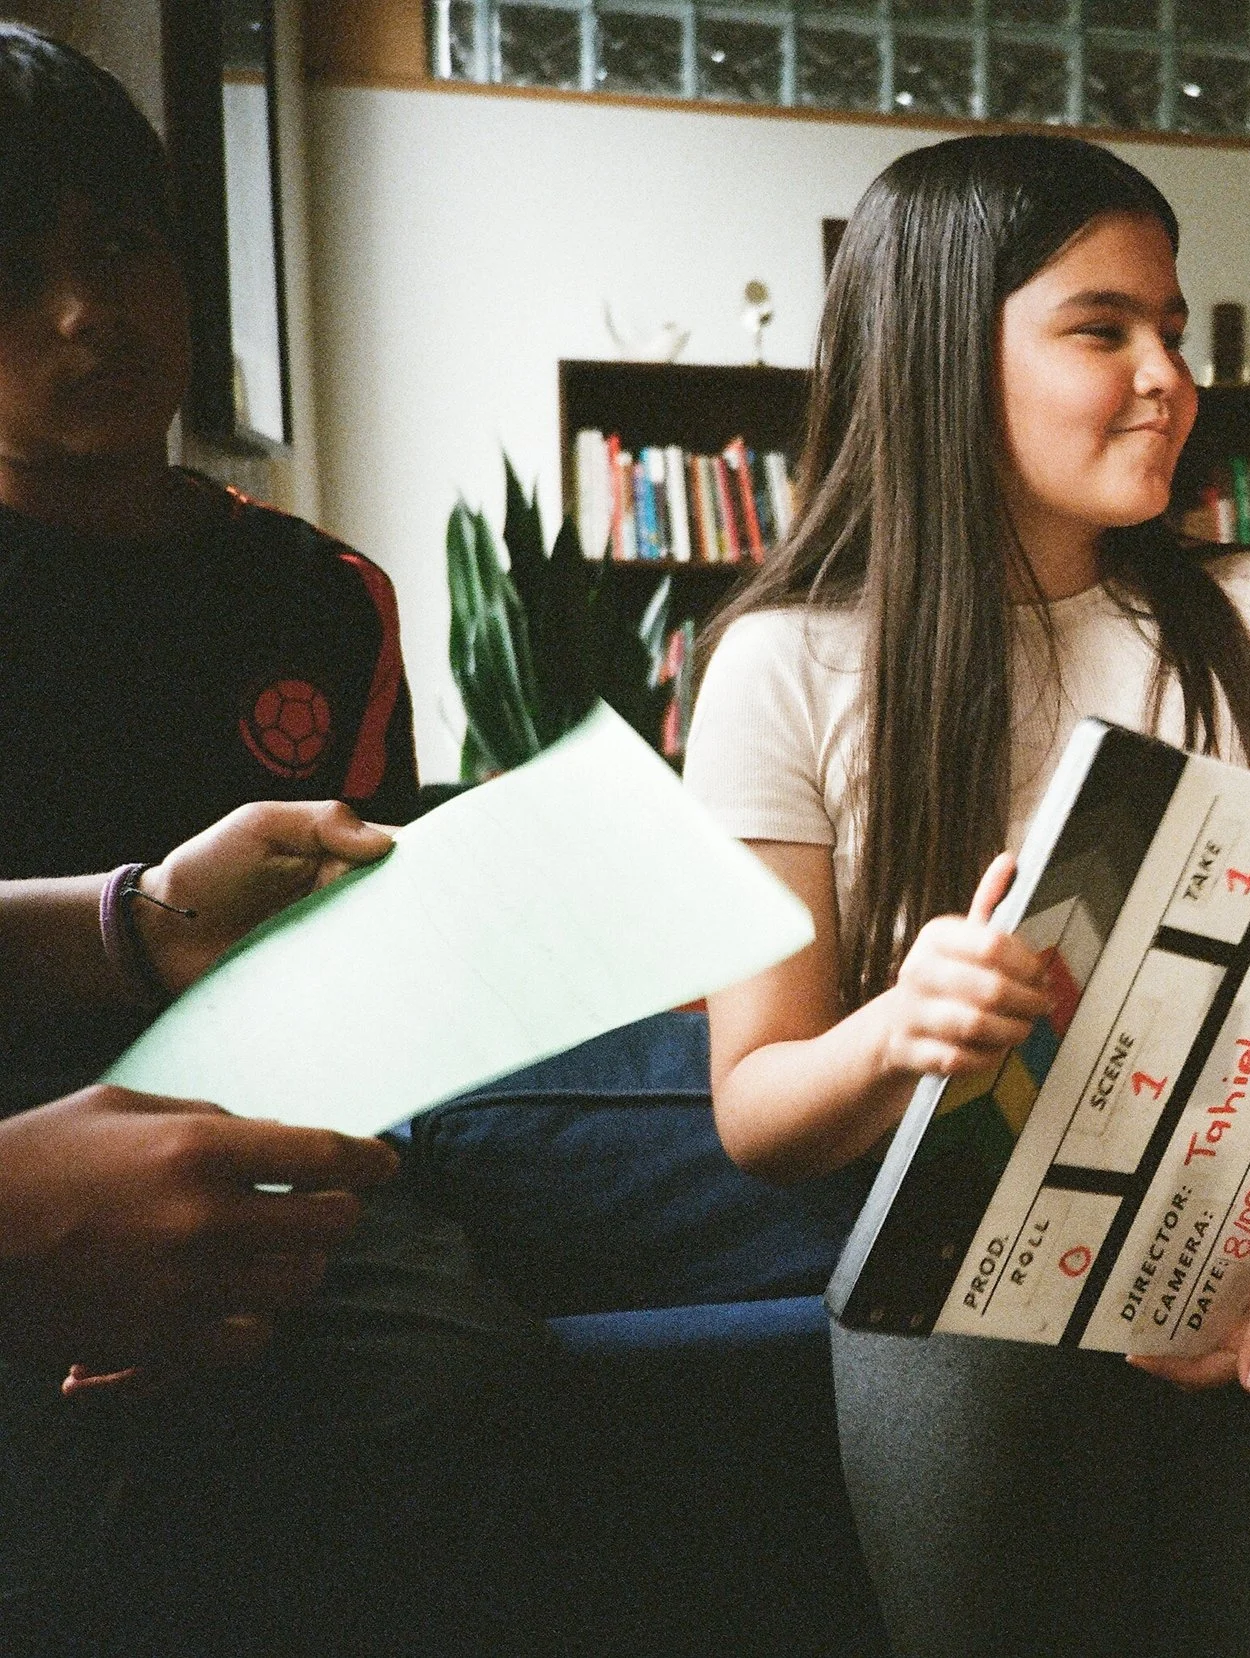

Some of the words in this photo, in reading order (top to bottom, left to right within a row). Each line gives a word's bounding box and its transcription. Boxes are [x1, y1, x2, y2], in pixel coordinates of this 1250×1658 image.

[1182, 839, 1221, 902] TAKE
[1090, 1030, 1135, 1113] SCENE
[1130, 1070, 1168, 1101] 1
[962, 1234, 1009, 1311] PROD.
[1009, 1218, 1050, 1287] ROLL
[1120, 1184, 1193, 1323] DIRECTOR:
[1153, 1209, 1215, 1328] CAMERA:
